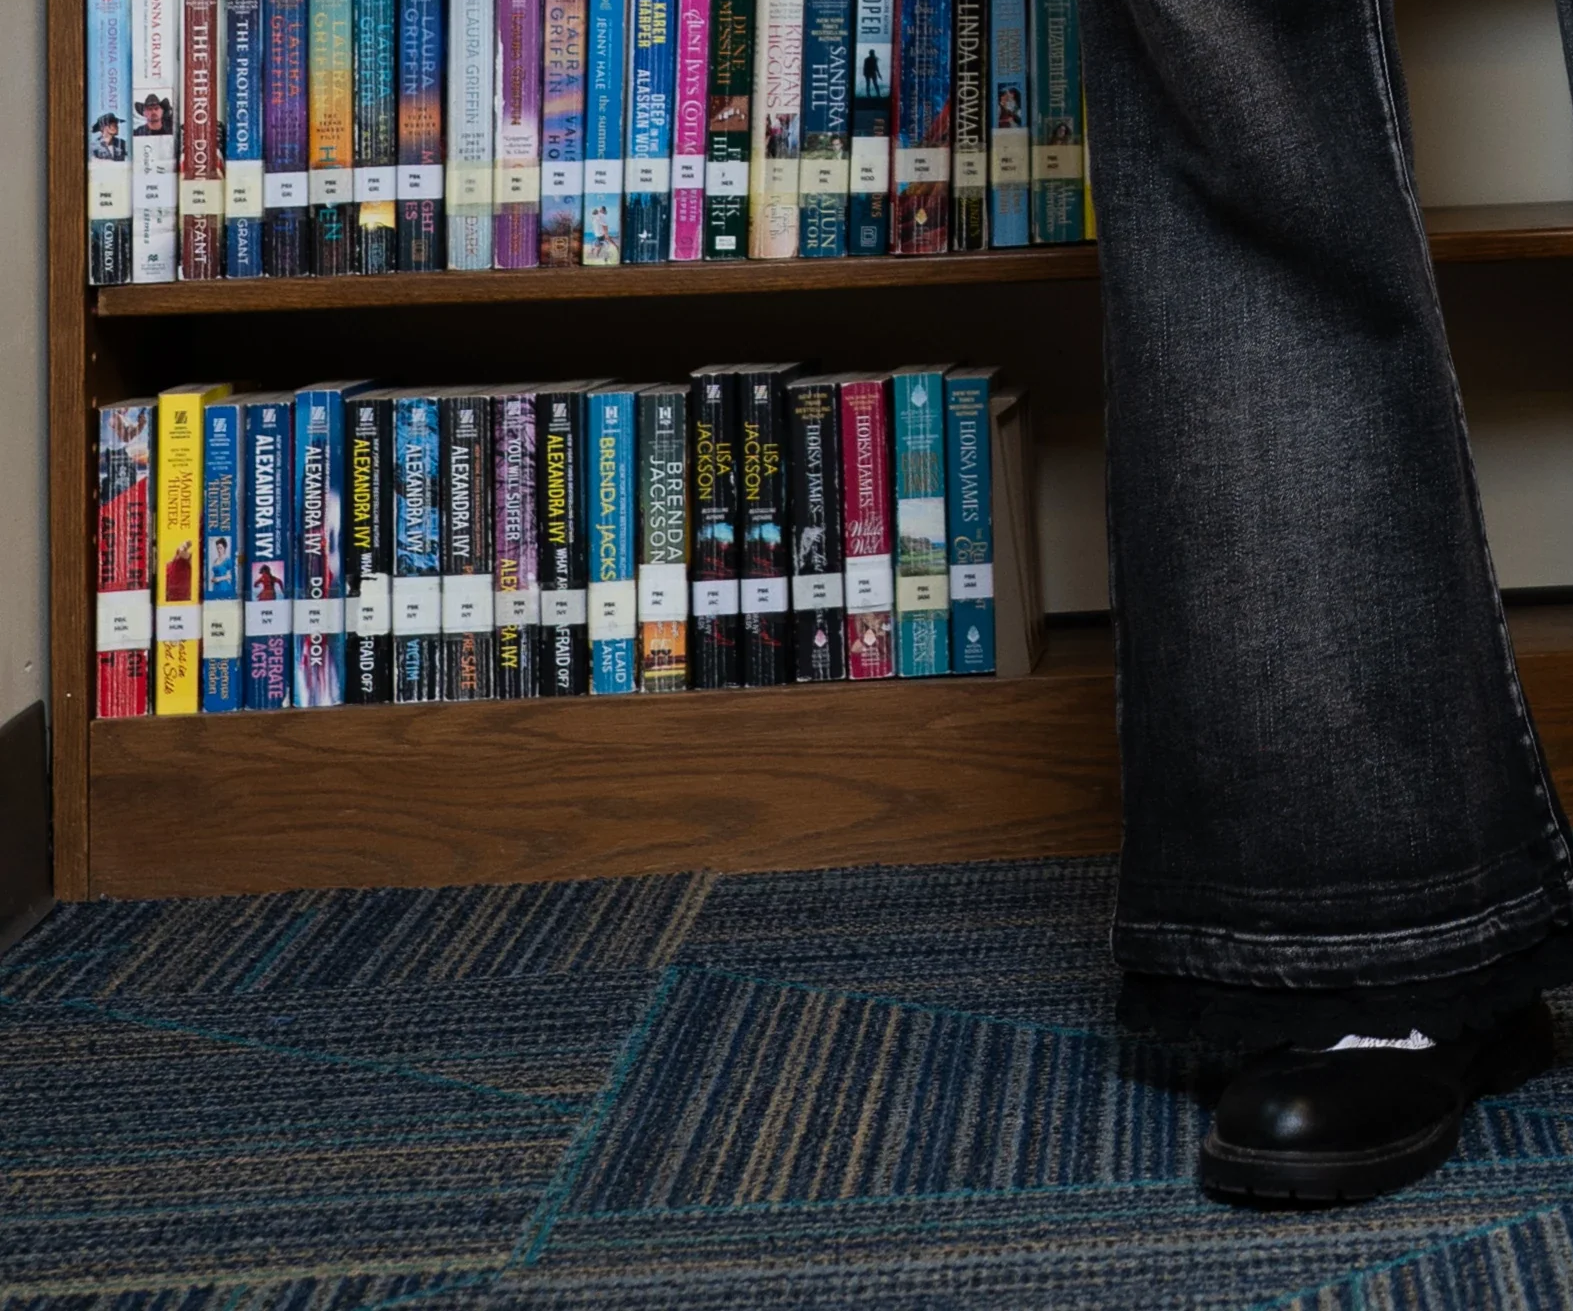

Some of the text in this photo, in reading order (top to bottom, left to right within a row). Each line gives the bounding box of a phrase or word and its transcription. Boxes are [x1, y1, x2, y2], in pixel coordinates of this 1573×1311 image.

[405, 7, 419, 95] GRIFFIN
[421, 15, 437, 89] LAURA
[594, 16, 607, 90] JENNY HALE
[653, 1, 667, 43] KAREN
[717, 1, 732, 85] MESSIAH
[732, 15, 747, 70] DUNE
[192, 21, 209, 125] THE HERO
[235, 18, 249, 153] THE PROTECTOR
[636, 69, 651, 128] ALASKAN
[767, 23, 783, 109] HIGGINS
[784, 23, 802, 108] KRISTAN
[811, 63, 828, 111] HILL
[829, 45, 847, 127] SANDRA
[650, 93, 666, 126] DEEP
[254, 435, 274, 558] ALEXANDRA IVY
[505, 437, 521, 541] YOU WILL SUFFER
[743, 421, 761, 500] JACKSON
[763, 443, 778, 476] LISA
[649, 454, 666, 564] JACKSON
[667, 462, 683, 561] BRENDA
